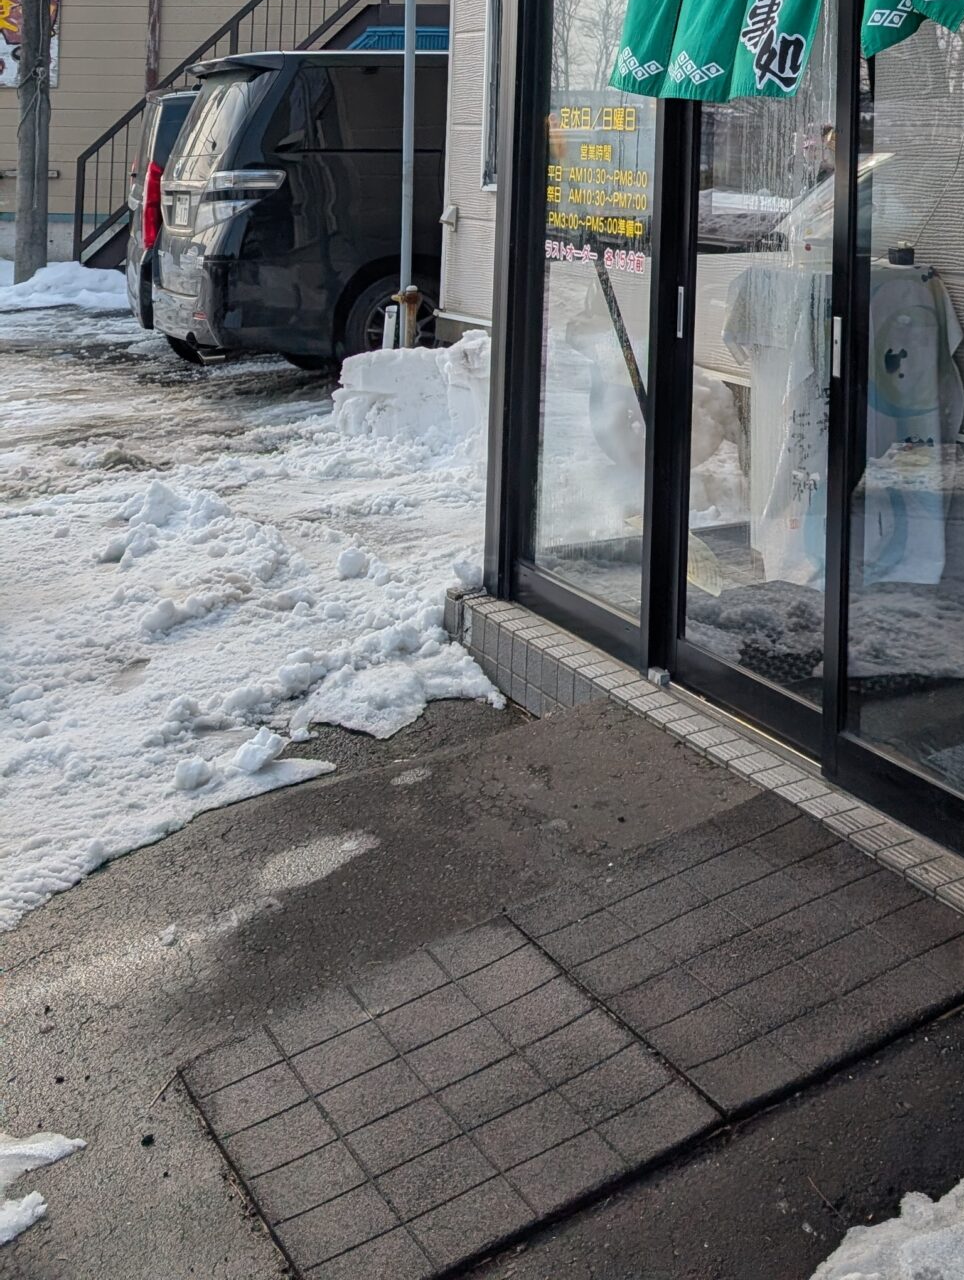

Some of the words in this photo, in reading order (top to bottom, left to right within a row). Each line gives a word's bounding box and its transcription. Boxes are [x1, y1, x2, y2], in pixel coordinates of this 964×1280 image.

[580, 144, 613, 163] 営業時間
[547, 165, 562, 182] 平日
[545, 239, 598, 264] ラストオーダー
